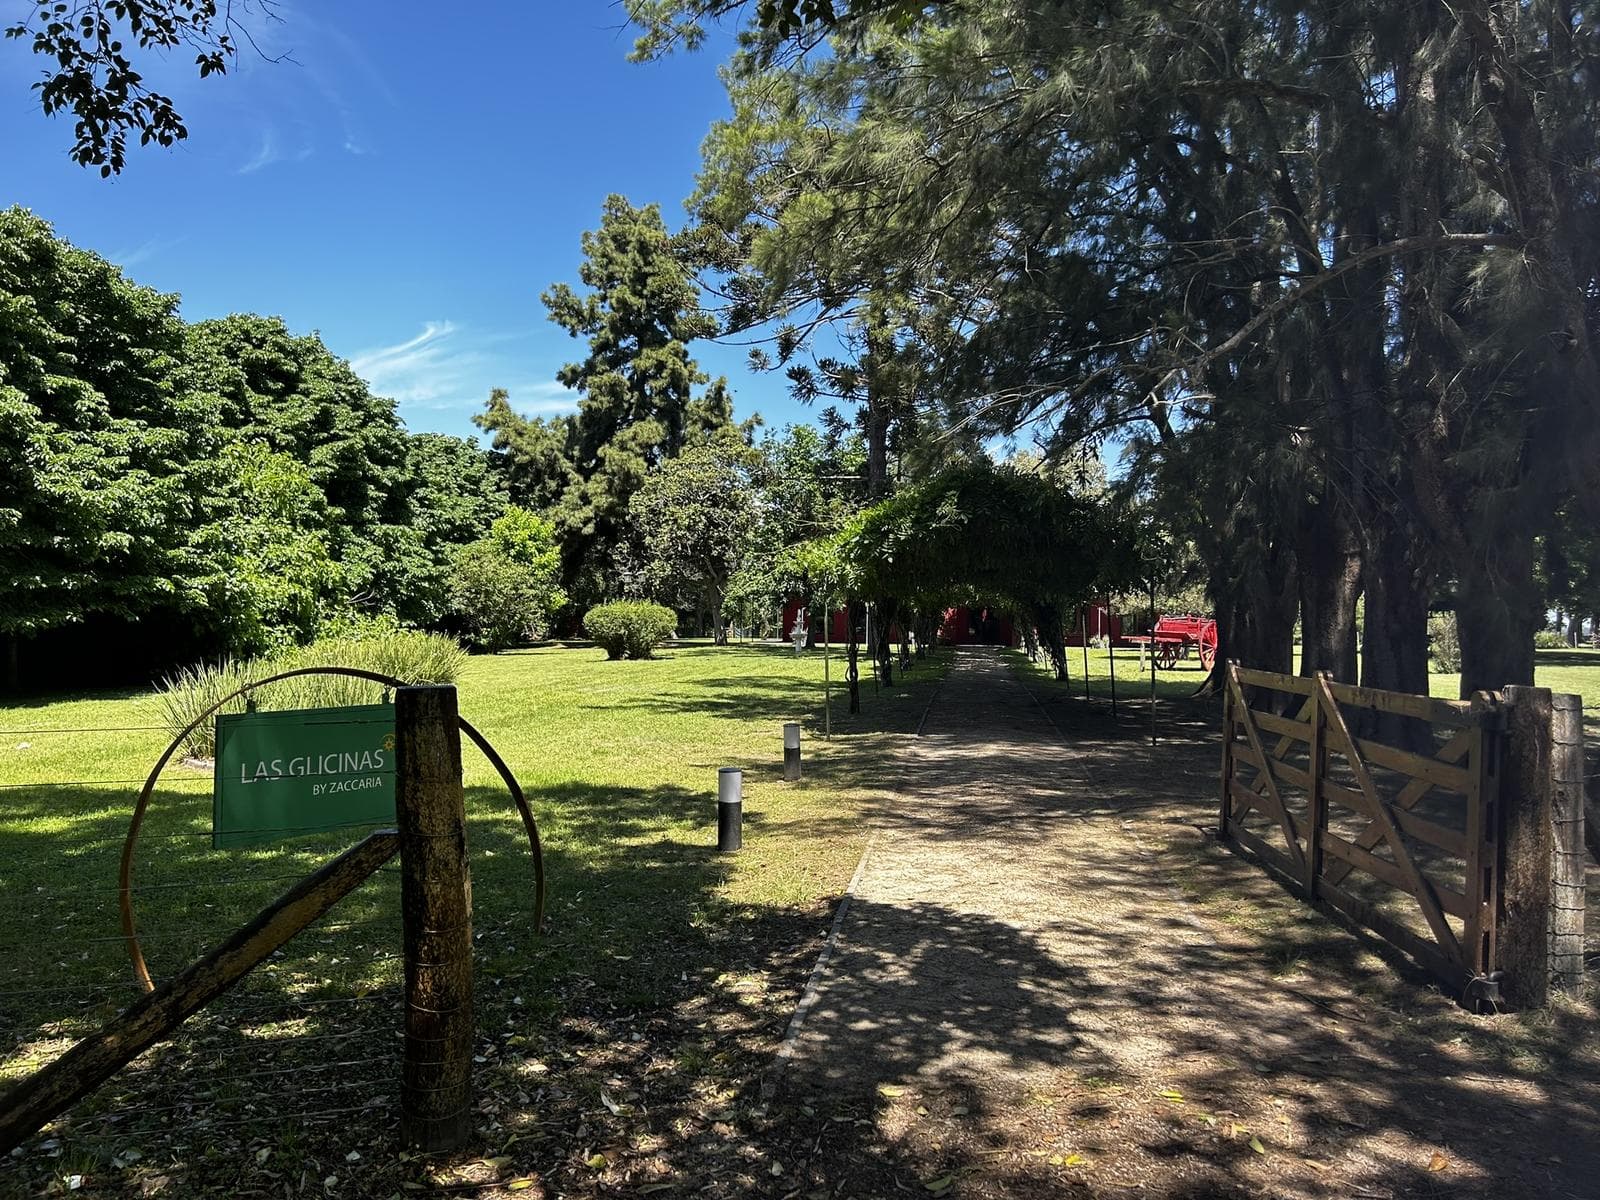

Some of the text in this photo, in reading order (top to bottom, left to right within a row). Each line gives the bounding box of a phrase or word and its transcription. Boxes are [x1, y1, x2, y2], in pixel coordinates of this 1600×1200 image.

[241, 749, 384, 784] LAS GLICINAS
[313, 777, 382, 796] BY ZACCARIA
